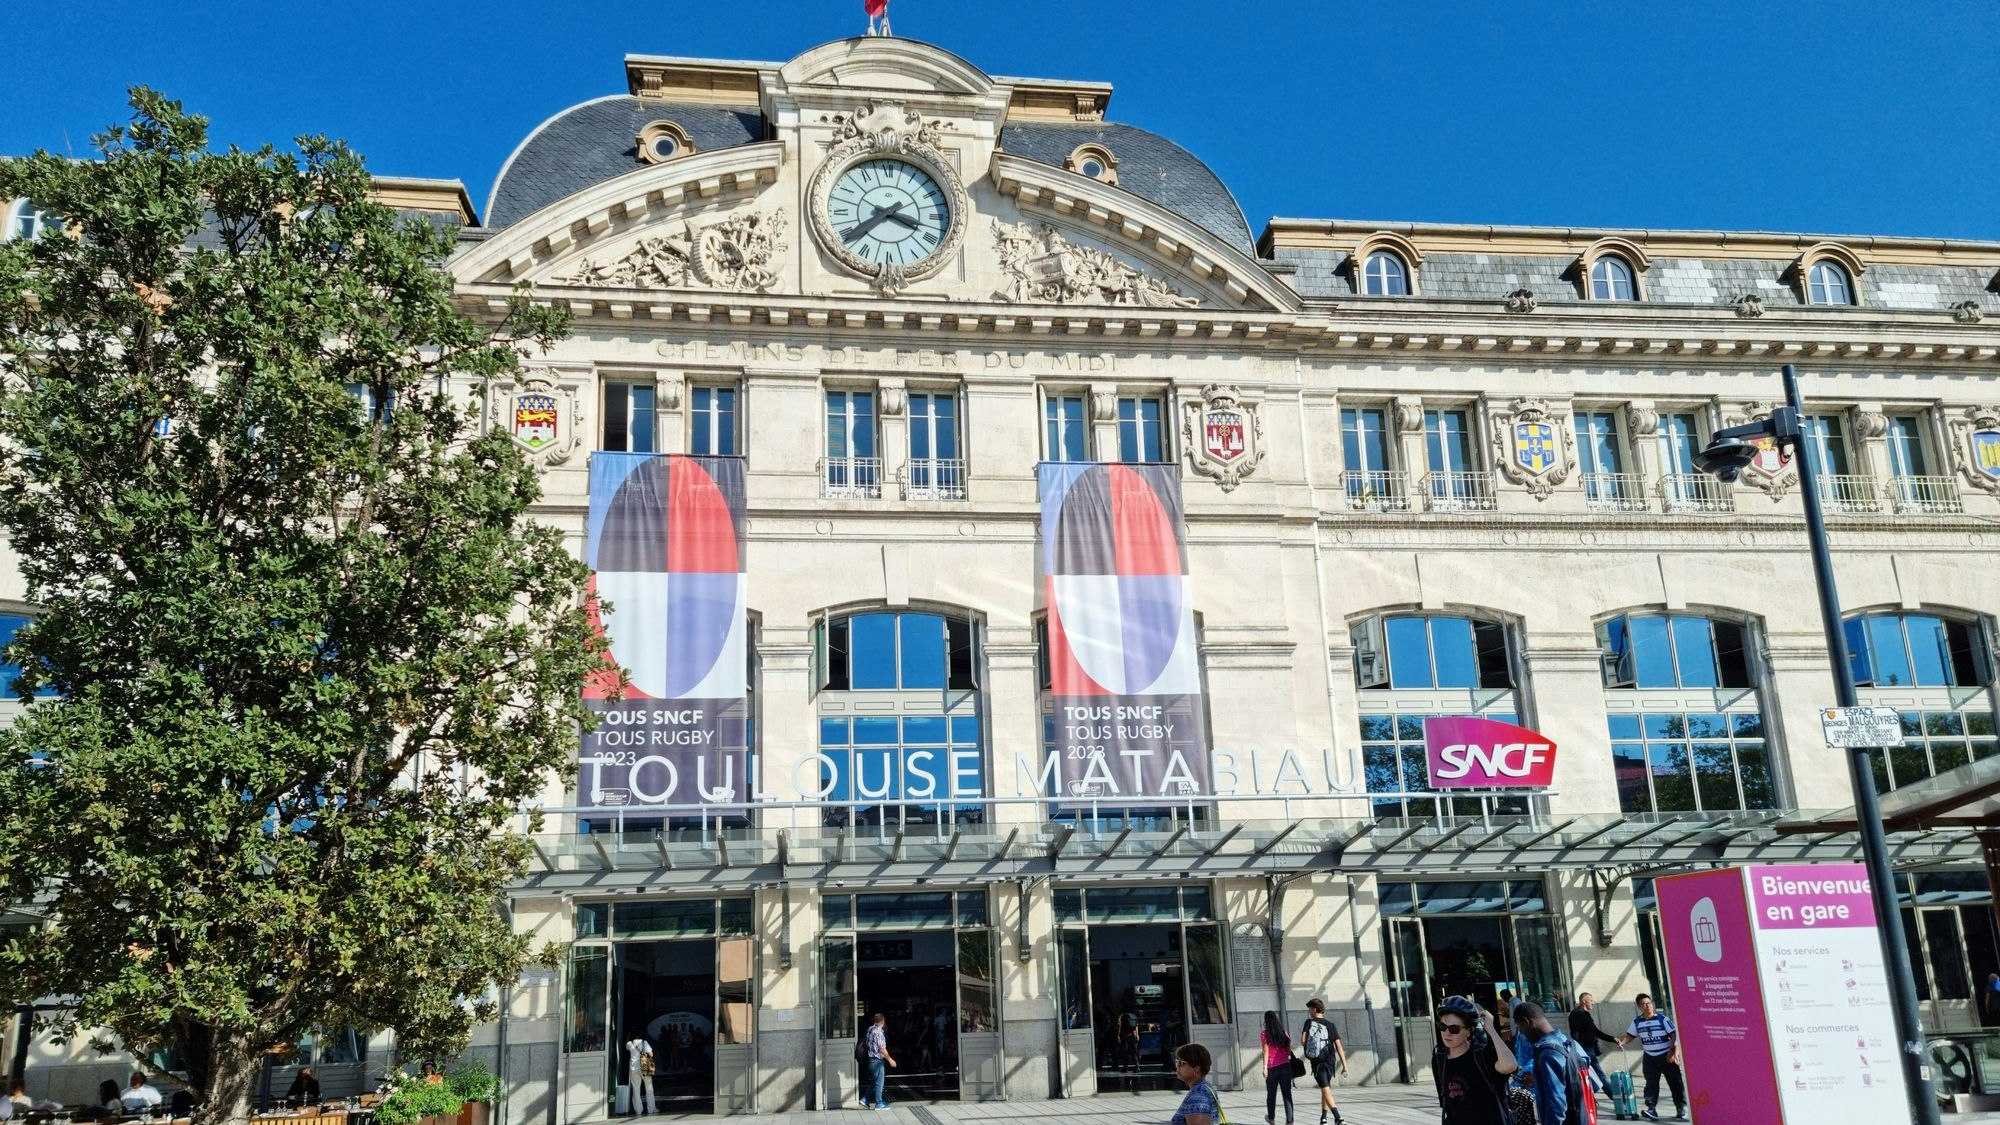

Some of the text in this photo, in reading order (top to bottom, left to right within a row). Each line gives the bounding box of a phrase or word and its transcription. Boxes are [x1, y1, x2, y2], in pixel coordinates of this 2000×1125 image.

[656, 343, 1116, 371] CHEMINS DE FER DU MIDI
[652, 709, 703, 724] SNCF
[1064, 705, 1162, 720] TOUS SNCF
[1844, 707, 1875, 716] ESPACE
[1848, 715, 1899, 726] MALGOUYRES
[594, 730, 715, 746] TOUS RUGBY
[1065, 724, 1175, 740] TOUS RUGBY
[1067, 745, 1105, 759] 2023
[1436, 743, 1550, 778] SNCF
[578, 748, 1357, 803] TOULOUSE MATABIAU
[1762, 876, 1872, 895] Bienvenue
[1766, 905, 1850, 925] en gare
[1773, 946, 1830, 956] Nos services
[1785, 1024, 1860, 1034] Nos commerces
